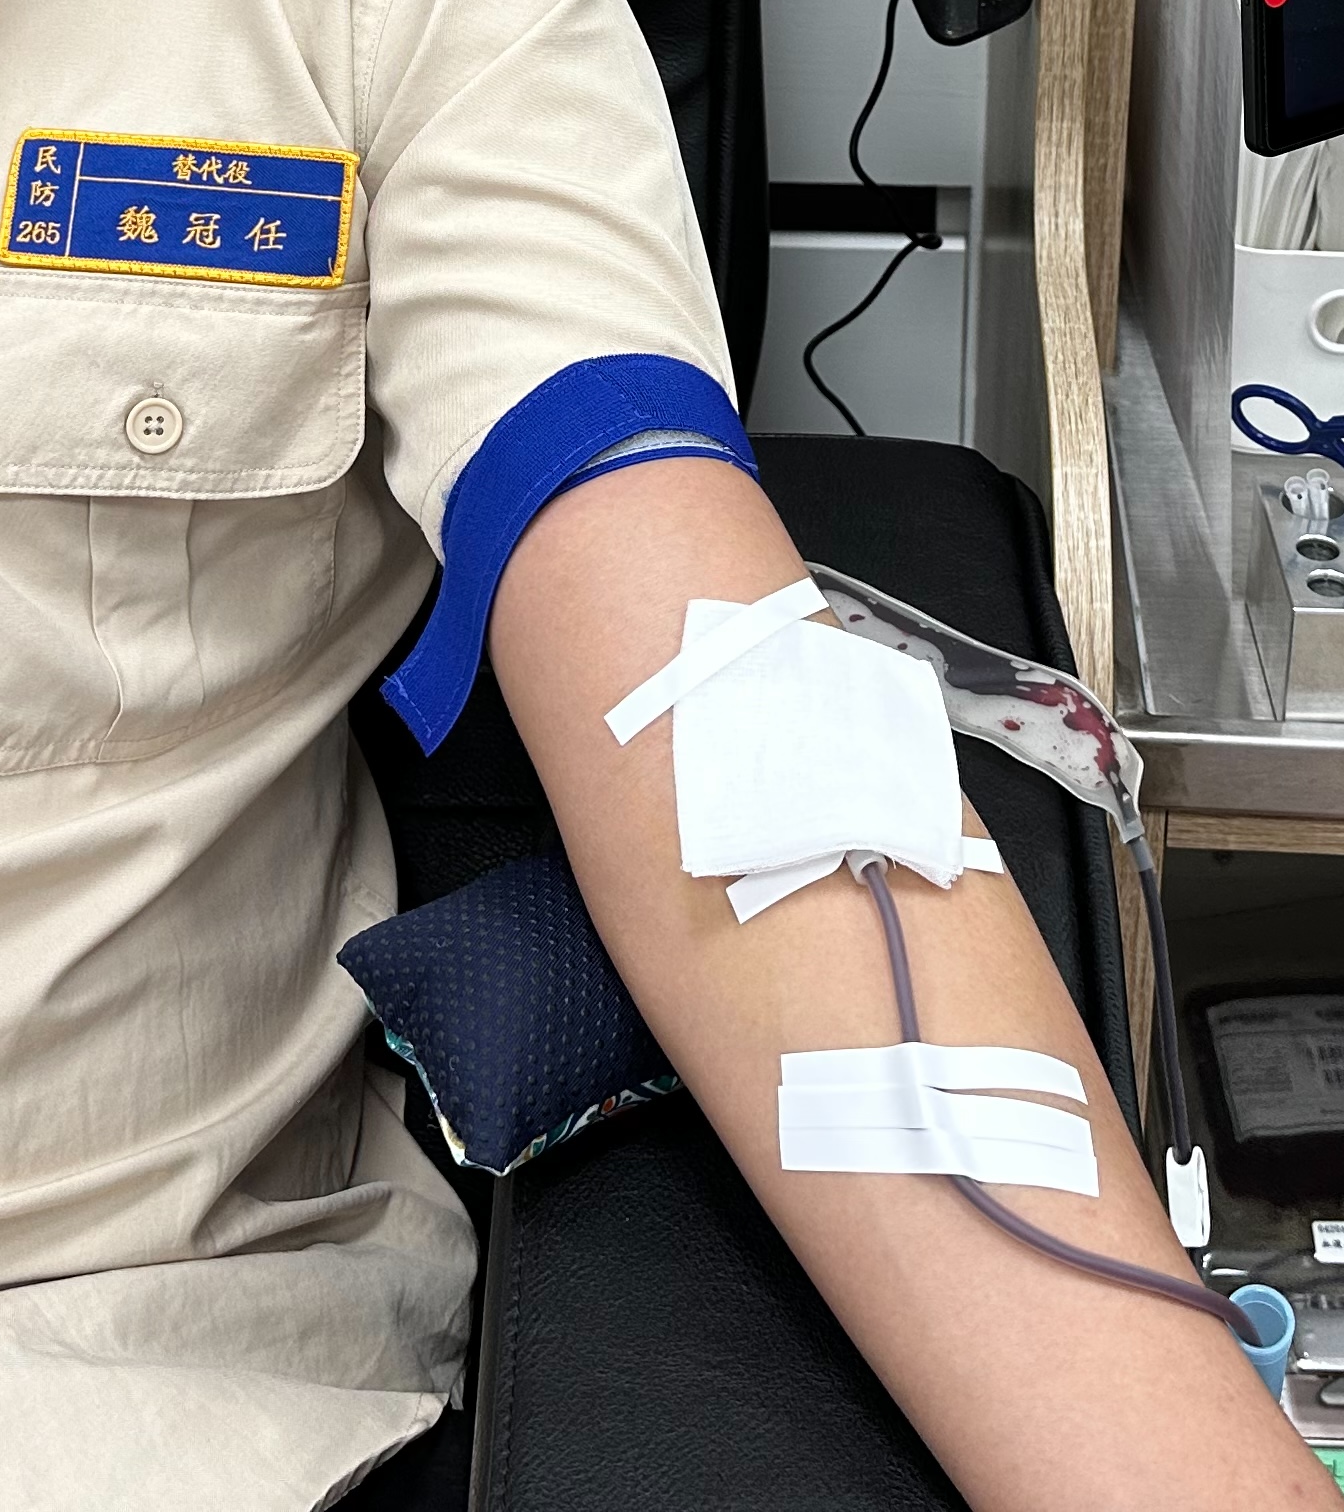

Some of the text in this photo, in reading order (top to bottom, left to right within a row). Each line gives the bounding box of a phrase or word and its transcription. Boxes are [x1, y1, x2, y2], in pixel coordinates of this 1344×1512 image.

[29, 144, 61, 208] 民防
[171, 155, 253, 185] 替代役
[16, 220, 61, 245] 265
[116, 205, 288, 251] 魏冠任
